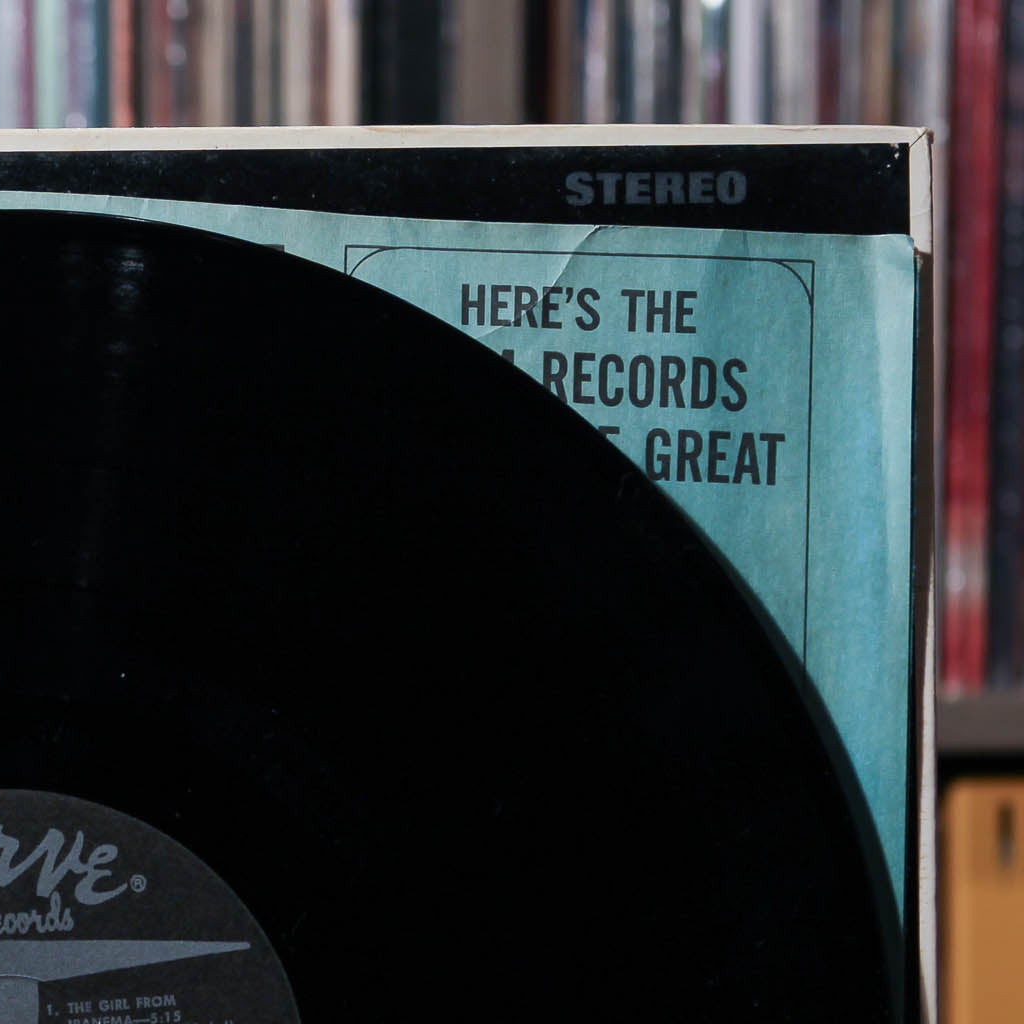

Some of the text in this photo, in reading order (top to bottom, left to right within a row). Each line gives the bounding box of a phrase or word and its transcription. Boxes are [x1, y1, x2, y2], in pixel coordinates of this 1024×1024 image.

[564, 170, 748, 207] STEREO
[461, 283, 699, 335] HERE'S THE
[542, 352, 749, 412] RECORDS
[644, 427, 786, 488] GREAT
[67, 1000, 92, 1015] THE
[98, 998, 131, 1012] GIRL
[135, 994, 177, 1009] FROM
